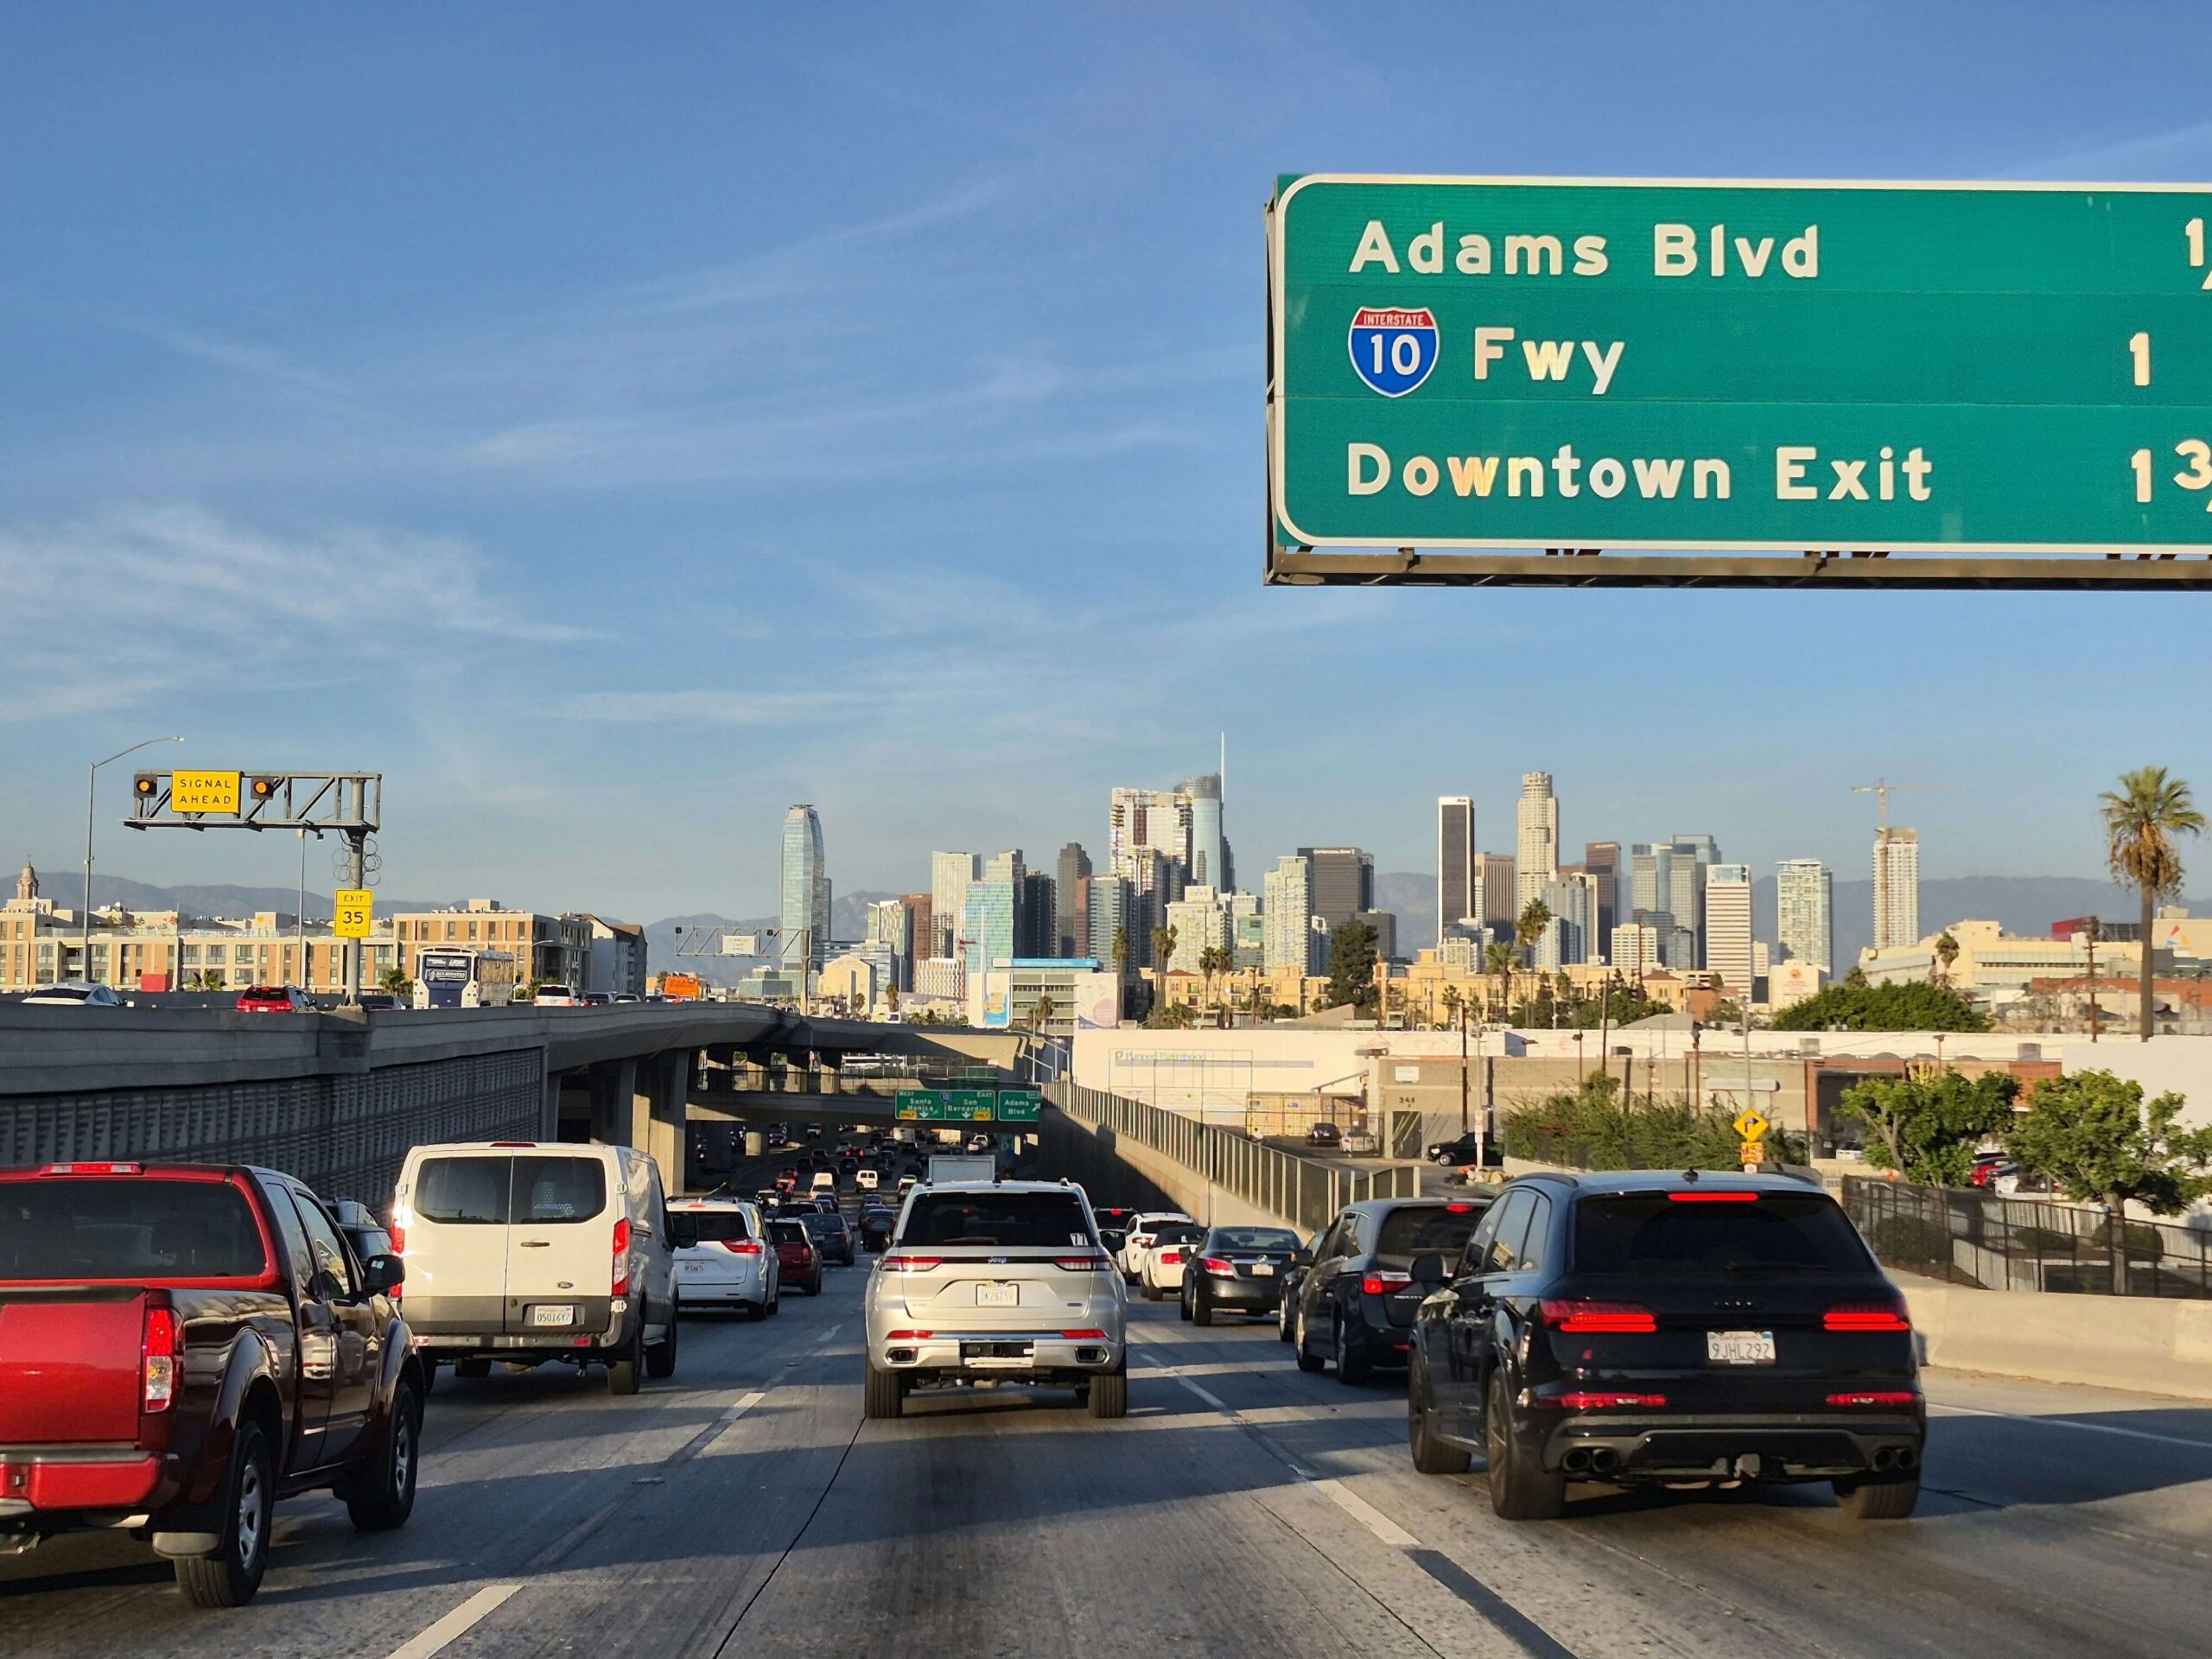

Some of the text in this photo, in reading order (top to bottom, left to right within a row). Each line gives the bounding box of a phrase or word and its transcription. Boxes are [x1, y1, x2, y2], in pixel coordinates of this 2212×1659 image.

[1349, 219, 1609, 276] Adams
[1654, 223, 1818, 278] Blvd
[1363, 314, 1424, 326] INTERSTATE
[1370, 327, 2150, 394] 10 Fwy 1
[1348, 442, 1731, 499] Downtown
[1777, 446, 1932, 501] Exit
[2132, 448, 2152, 502] 1
[180, 779, 232, 789] SIGNAL
[179, 795, 231, 804] AHEAD
[342, 911, 364, 924] 35
[1712, 1343, 1770, 1360] 9JHL292
